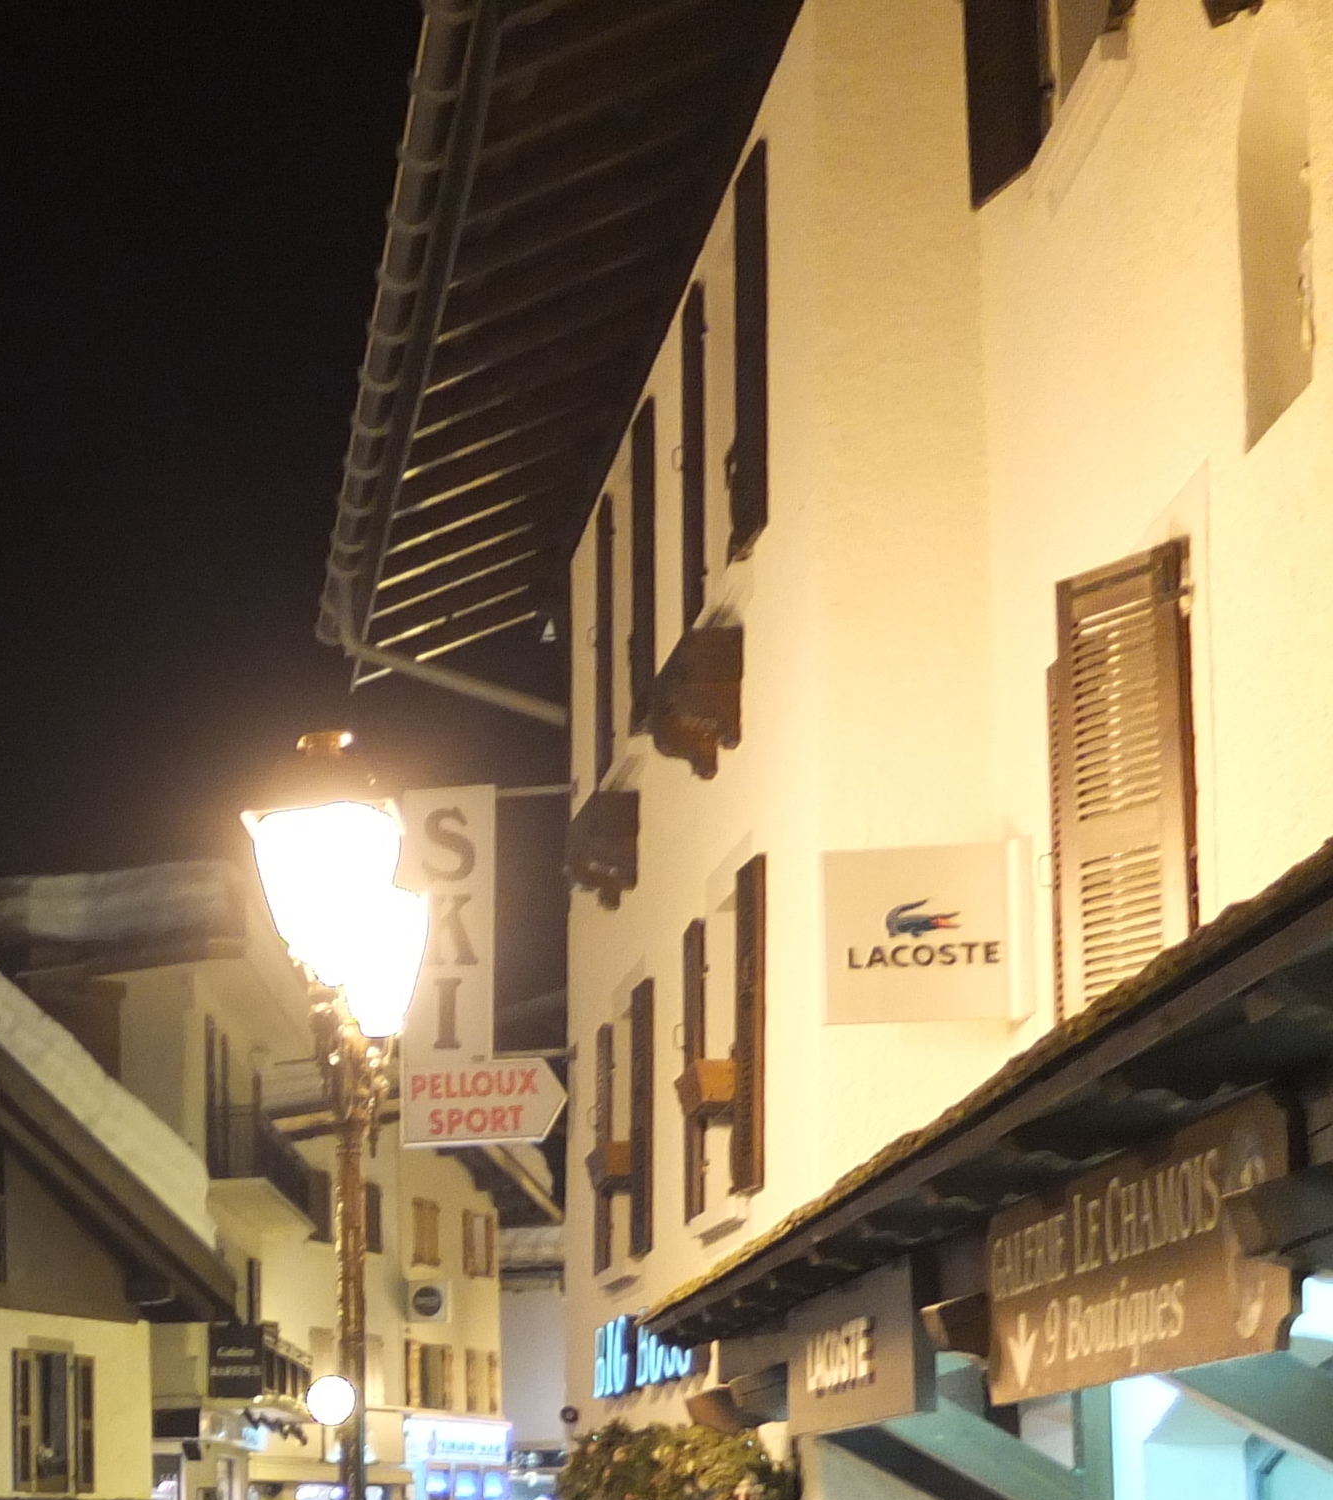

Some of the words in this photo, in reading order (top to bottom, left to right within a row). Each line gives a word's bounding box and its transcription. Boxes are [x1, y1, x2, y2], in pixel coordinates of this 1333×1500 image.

[422, 806, 478, 1049] SKI
[847, 940, 1002, 970] LACOSTE
[410, 1068, 540, 1101] PELLOUX
[428, 1104, 525, 1136] SPORT
[1106, 1148, 1222, 1264] CHAMOIS
[1044, 1299, 1062, 1368] 9
[1066, 1276, 1187, 1368] Boutiques
